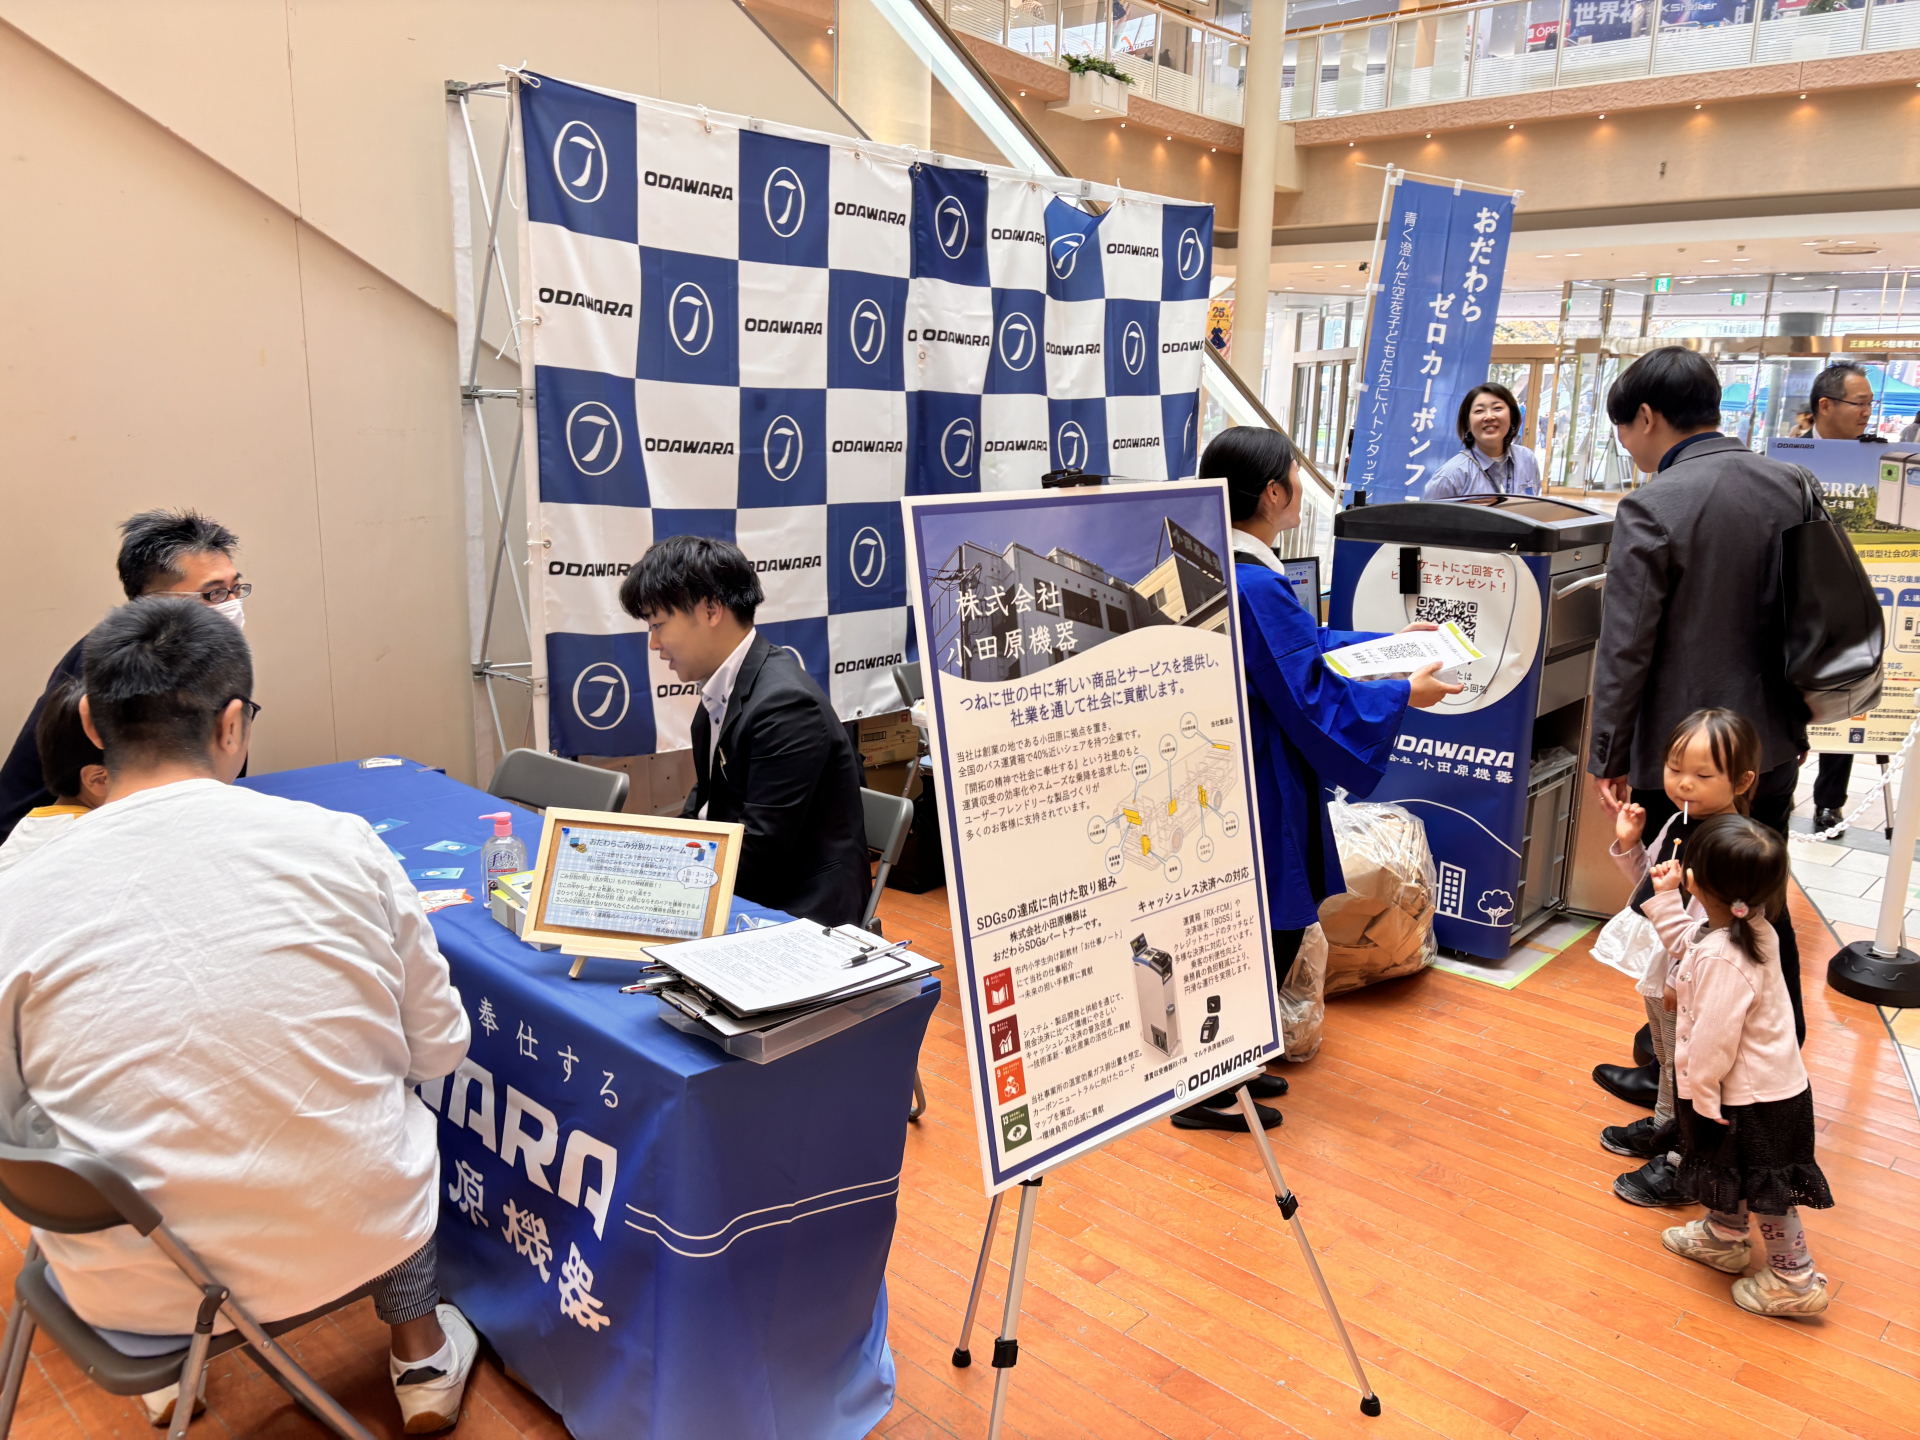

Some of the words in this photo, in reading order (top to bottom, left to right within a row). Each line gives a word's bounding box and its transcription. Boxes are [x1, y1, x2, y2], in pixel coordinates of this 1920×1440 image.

[1536, 26, 1559, 37] OPE
[644, 171, 734, 201] ODAWARA
[834, 202, 906, 226] ODAWARA
[991, 228, 1045, 247] ODAWARA
[1107, 243, 1159, 258] ODAWARA
[1461, 207, 1500, 322] おだわら
[538, 287, 633, 318] ODAWARA
[744, 318, 823, 335] ODAWARA
[922, 328, 990, 348] ODAWARA
[1046, 341, 1101, 356] ODAWARA
[1404, 293, 1456, 501] ゼロカーボンフ
[645, 437, 734, 456] ODAWARA
[832, 440, 903, 454] ODAWARA
[984, 439, 1048, 453] ODAWARA
[1112, 436, 1160, 451] ODAWARA
[548, 560, 632, 577] ODAWAR
[955, 581, 1063, 622] 株式会社
[946, 620, 1079, 668] 小田原機器
[834, 653, 902, 674] ODAWARA
[657, 684, 700, 699] ODA
[959, 653, 1220, 712] つねに世の中に新しい商品とサービスを提供し、
[1010, 678, 1185, 727] 社業を通して社会に貢献します。
[1394, 734, 1515, 769] DAWARA
[1137, 866, 1250, 913] キャッシュレス決済への対応
[976, 876, 1118, 931] SDGsの達成に向けた取り組み
[478, 996, 619, 1108] 奉仕する
[1187, 1045, 1262, 1092] ODAWARA
[449, 1159, 611, 1332] 原機器
